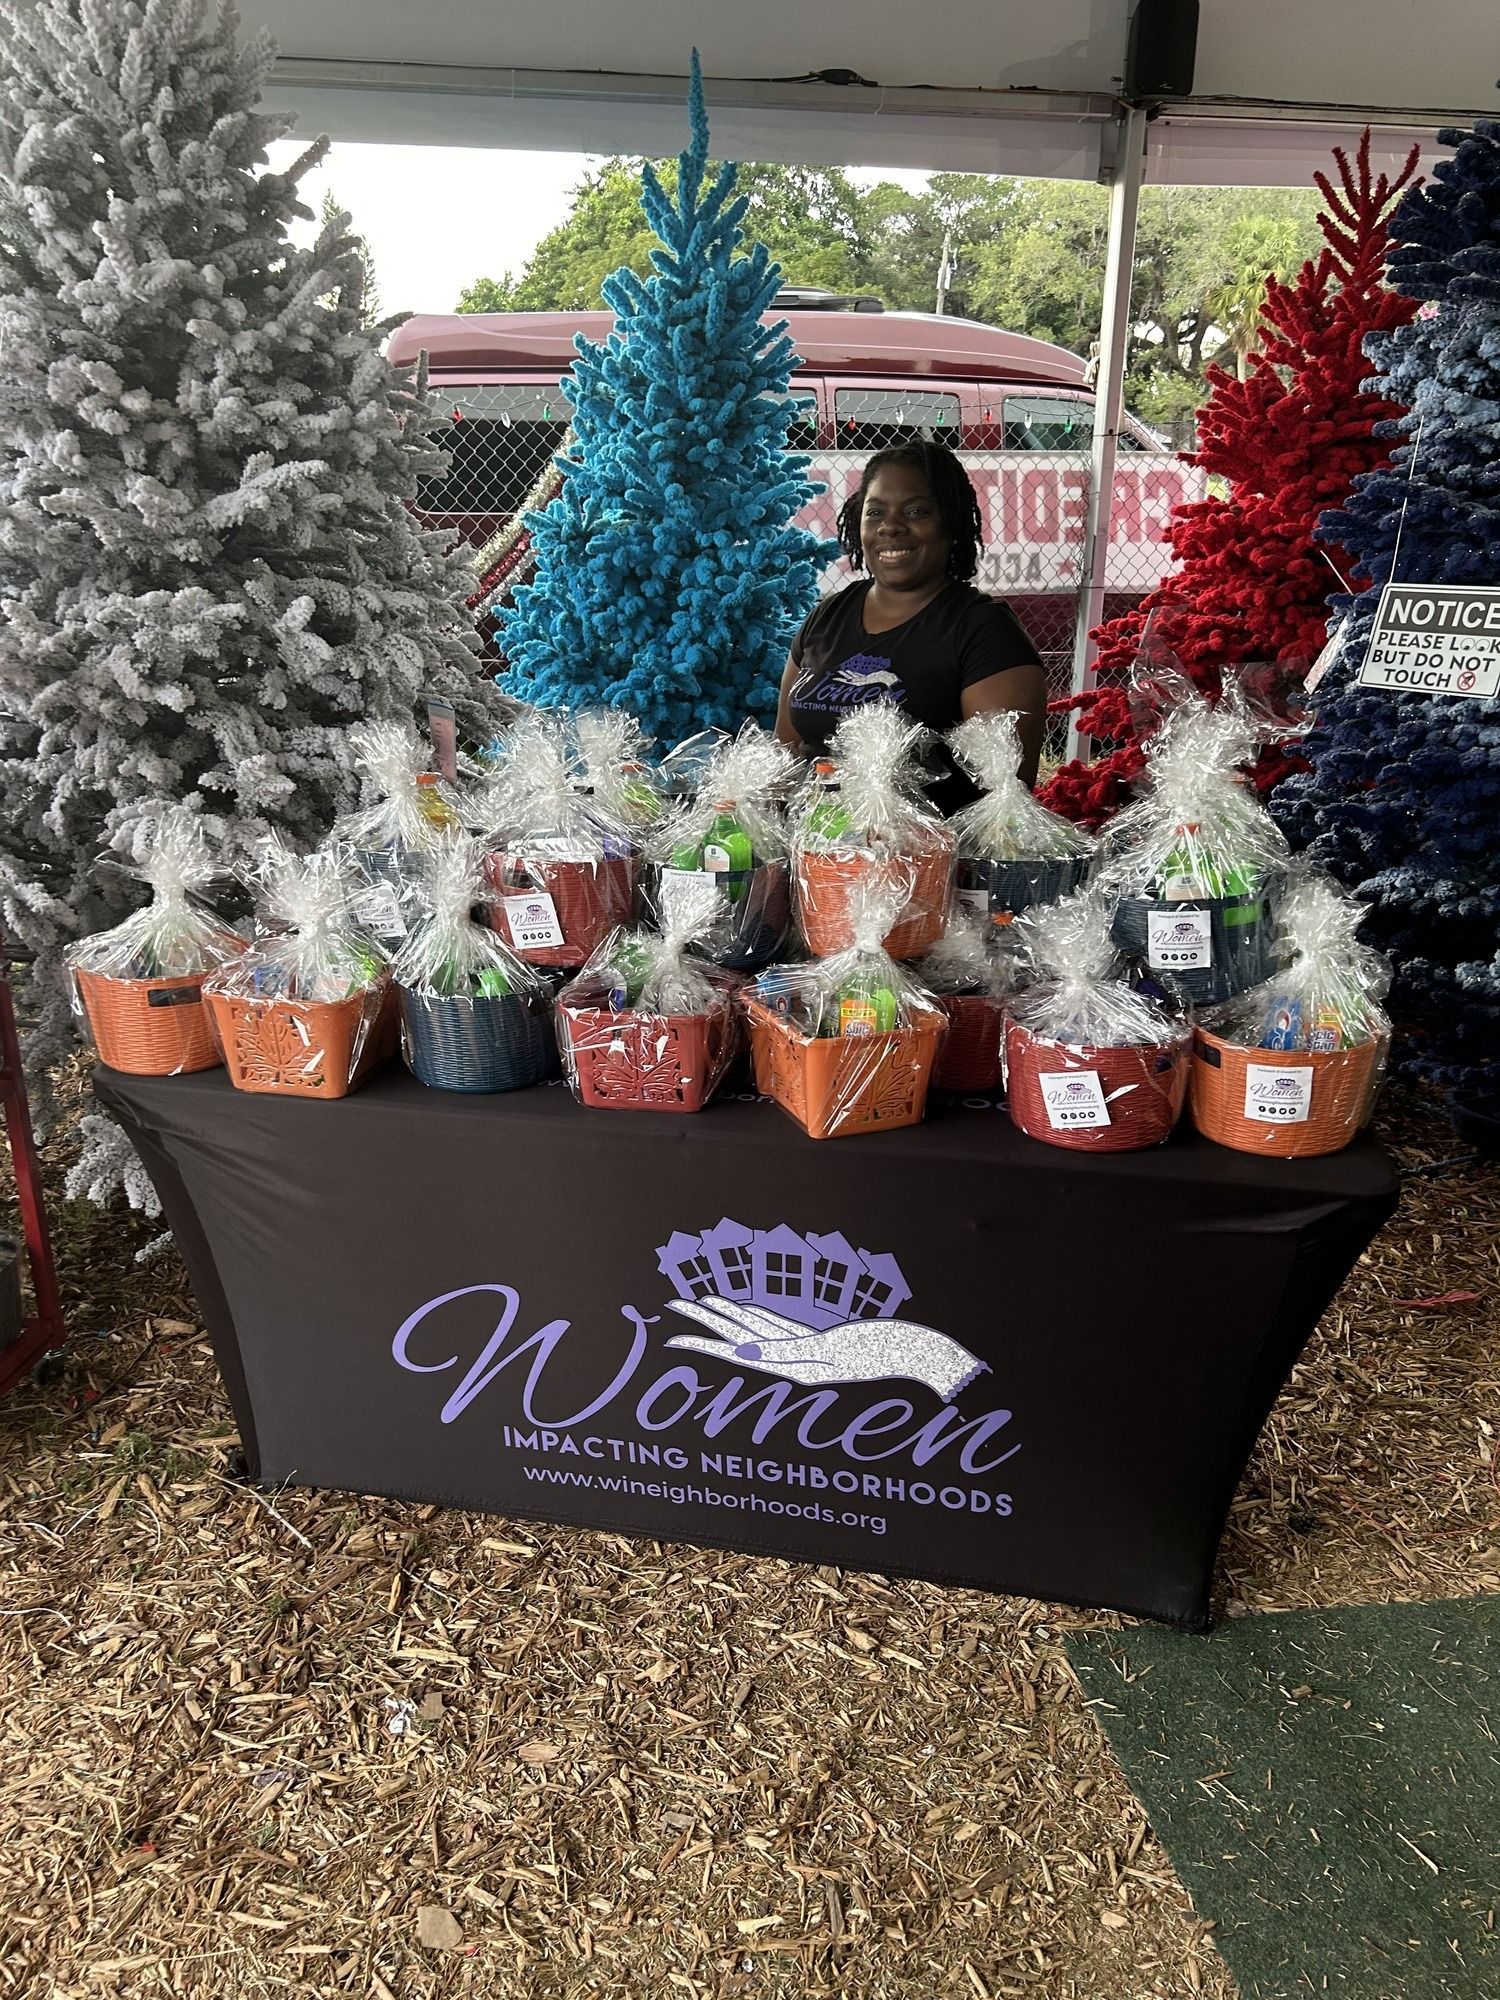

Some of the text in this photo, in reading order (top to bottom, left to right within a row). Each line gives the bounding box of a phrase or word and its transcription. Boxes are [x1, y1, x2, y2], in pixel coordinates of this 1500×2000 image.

[1388, 599, 1500, 629] NOTICE
[1376, 632, 1444, 650] PLEASE
[1371, 649, 1495, 672] BUT DO NOT
[1384, 668, 1451, 688] TOUCH
[1152, 929, 1203, 943] Women
[1047, 1090, 1097, 1105] Women
[1250, 1083, 1304, 1098] Women
[392, 1283, 1022, 1475] Women
[503, 1425, 1014, 1517] IMPACTING NEIGHBORHOODS
[523, 1466, 888, 1535] www.wineighborhoods.org
